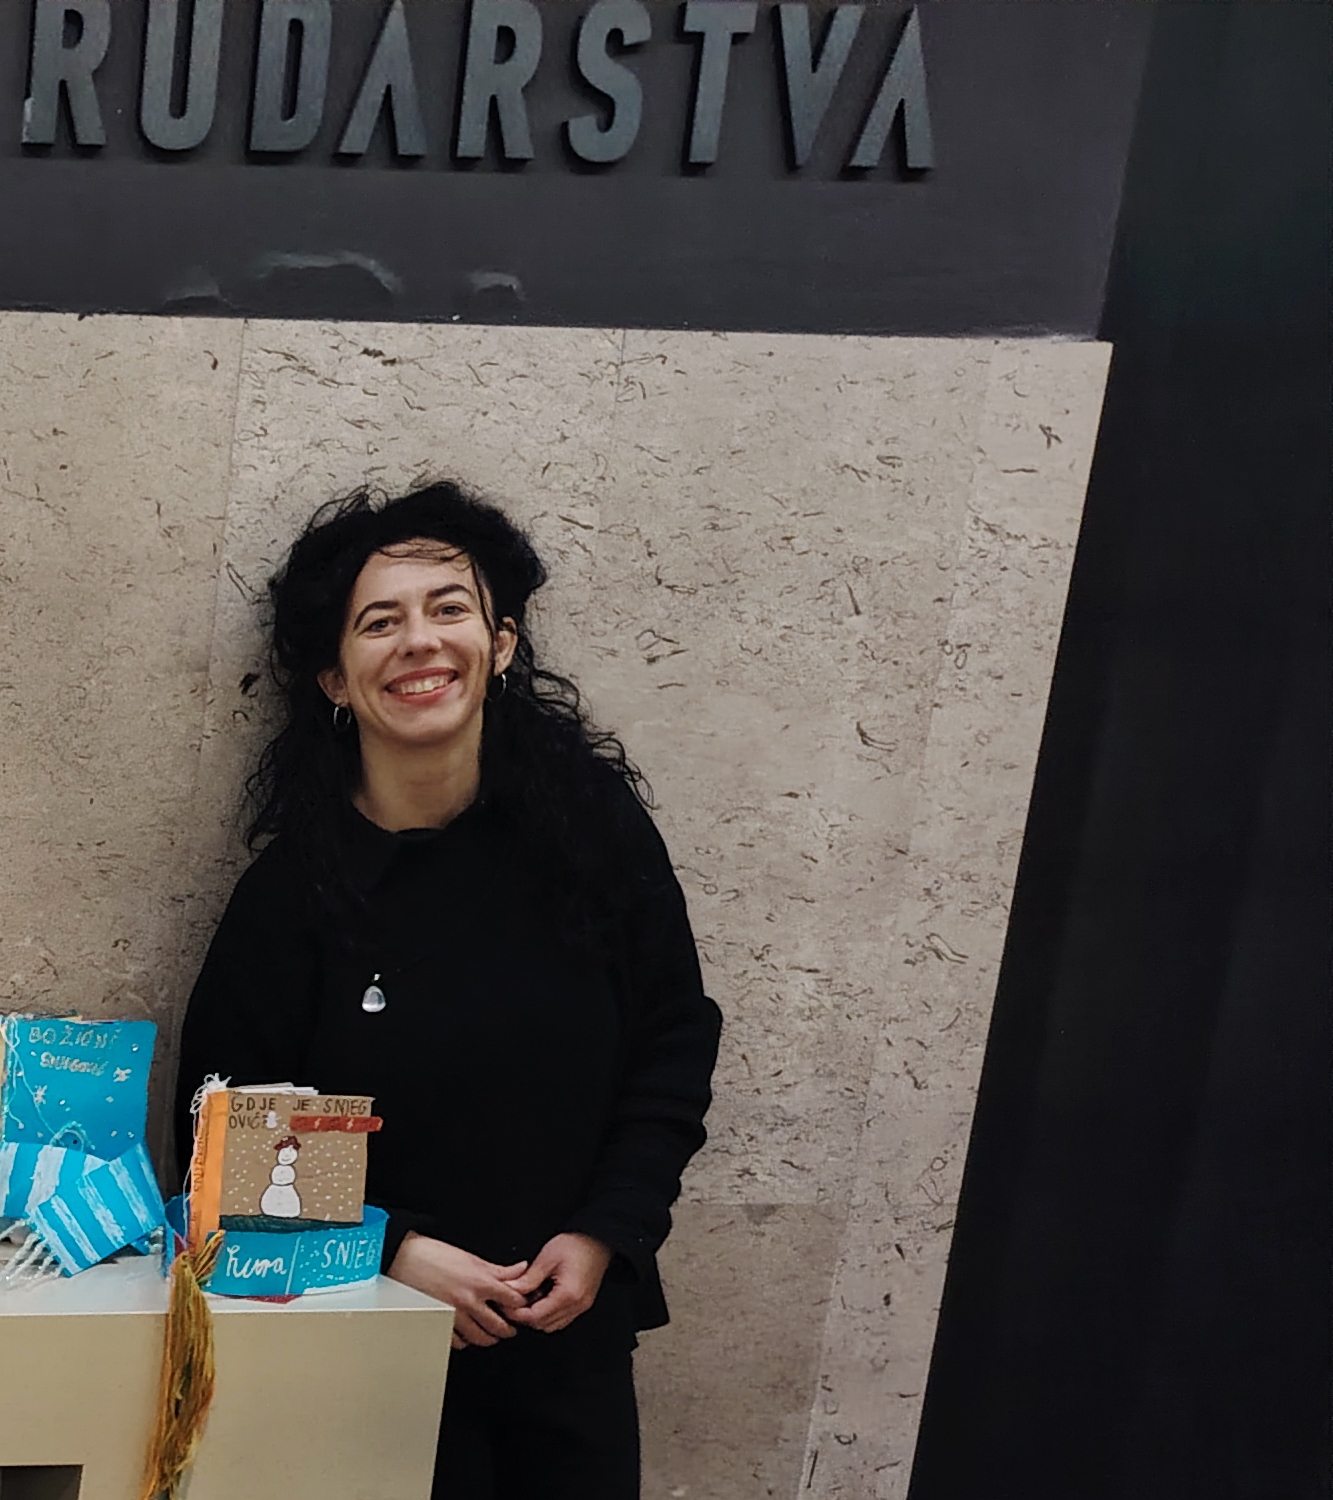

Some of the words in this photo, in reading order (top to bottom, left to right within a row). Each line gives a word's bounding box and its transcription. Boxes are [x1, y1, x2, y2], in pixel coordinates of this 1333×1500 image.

[22, 0, 935, 170] RUDARSTVA
[231, 1096, 277, 1113] GDJE
[293, 1098, 314, 1112] JE
